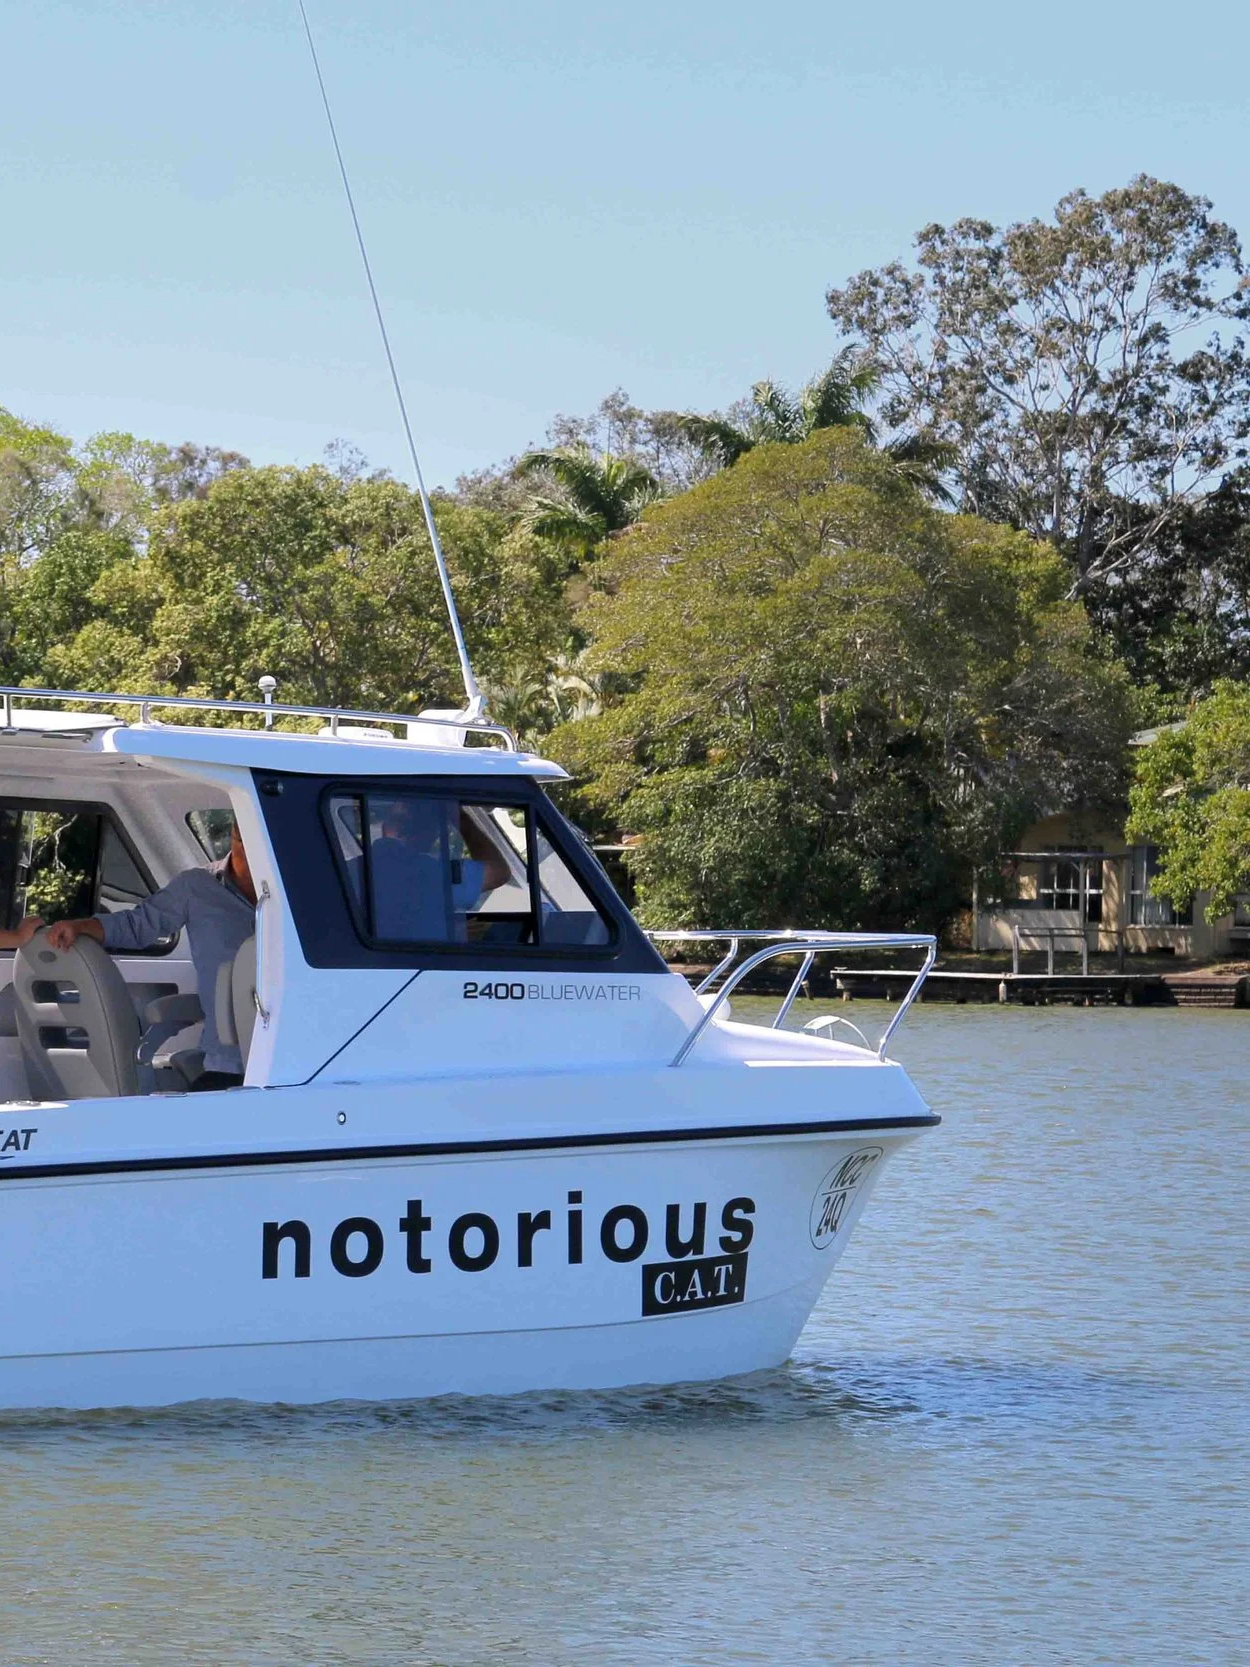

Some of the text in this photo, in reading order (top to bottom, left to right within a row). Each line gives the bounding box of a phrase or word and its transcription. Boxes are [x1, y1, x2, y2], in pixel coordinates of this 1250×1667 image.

[463, 982, 641, 1001] 2400 BLUEWATER
[262, 1190, 756, 1279] notorious
[654, 1264, 739, 1304] C.A.T.
